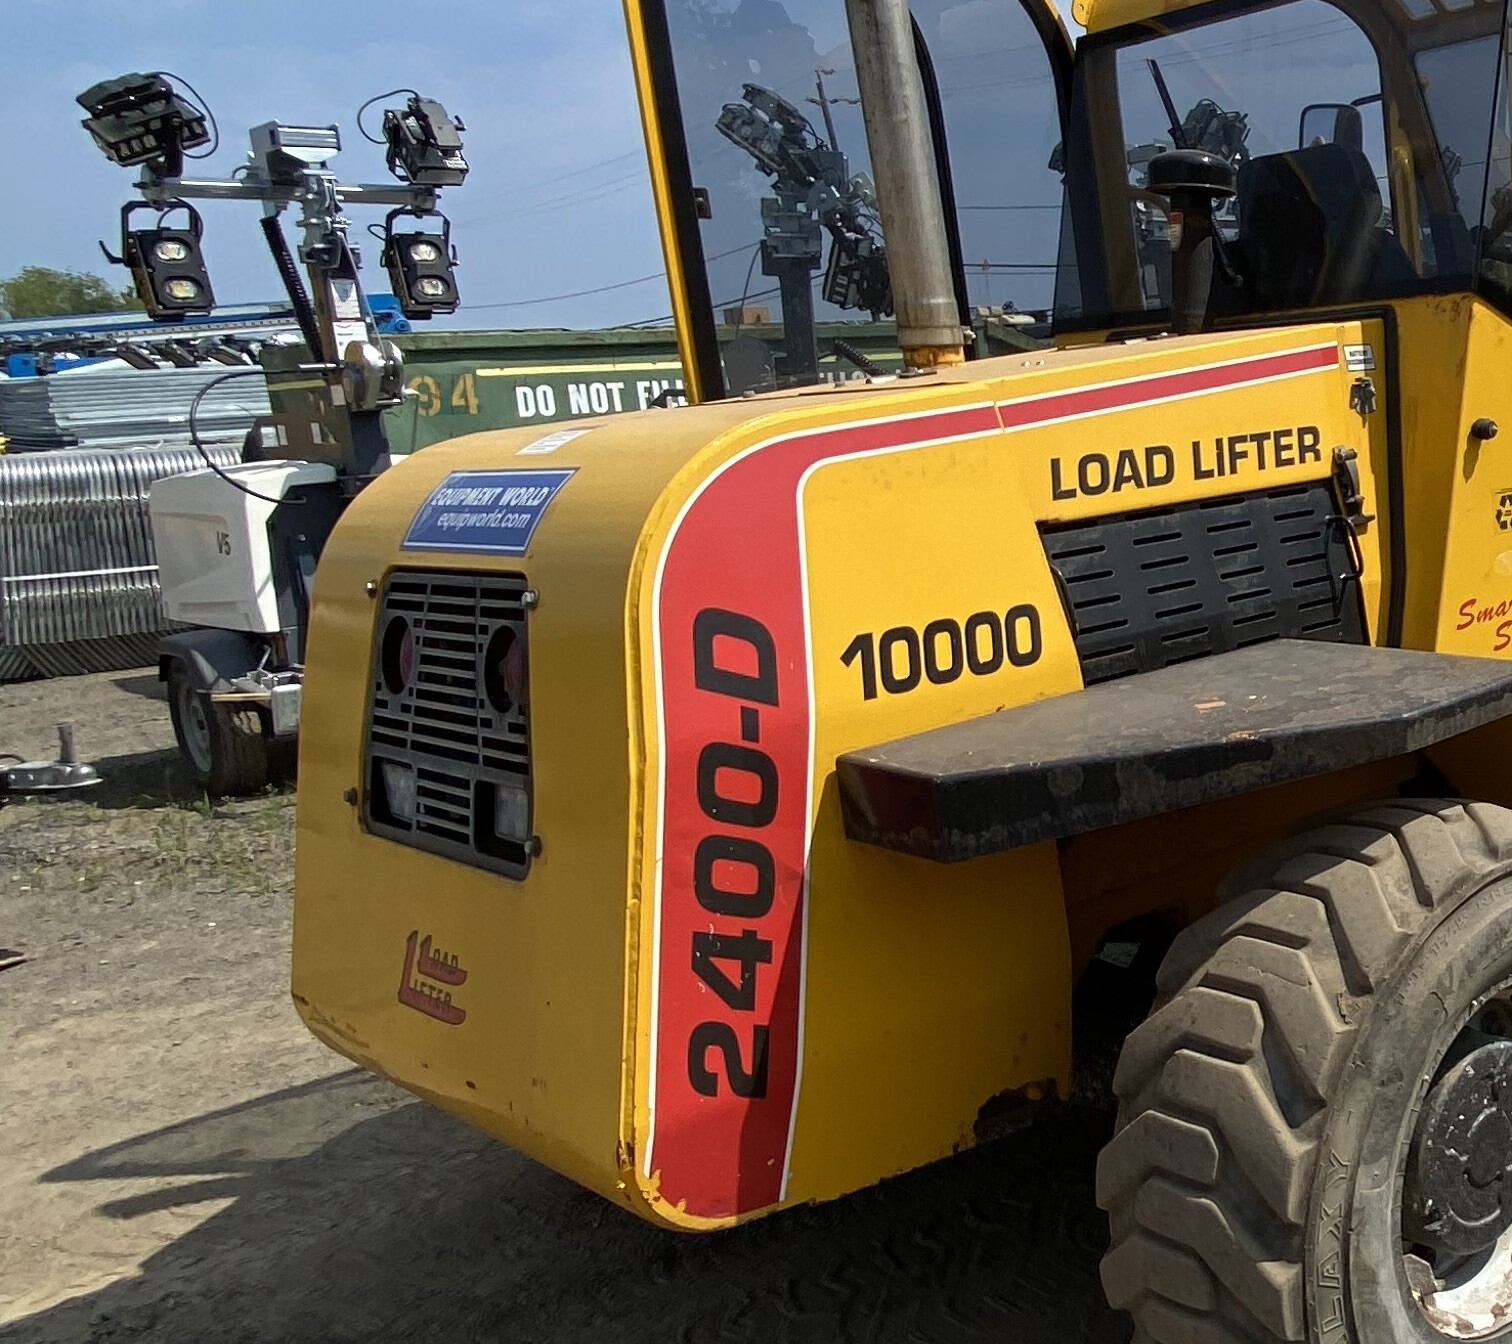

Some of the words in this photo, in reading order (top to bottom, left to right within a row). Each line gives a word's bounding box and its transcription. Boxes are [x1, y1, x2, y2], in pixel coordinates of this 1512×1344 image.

[515, 383, 557, 418] DO
[567, 381, 625, 415] NOT
[1050, 444, 1176, 501] LOAD
[1191, 425, 1322, 481] LIFTER
[431, 487, 503, 506] EQUIPMENT
[498, 486, 550, 506] WORLD
[437, 508, 531, 532] equipworld.com
[839, 603, 1043, 702] 10000
[687, 607, 780, 1100] 2400-D
